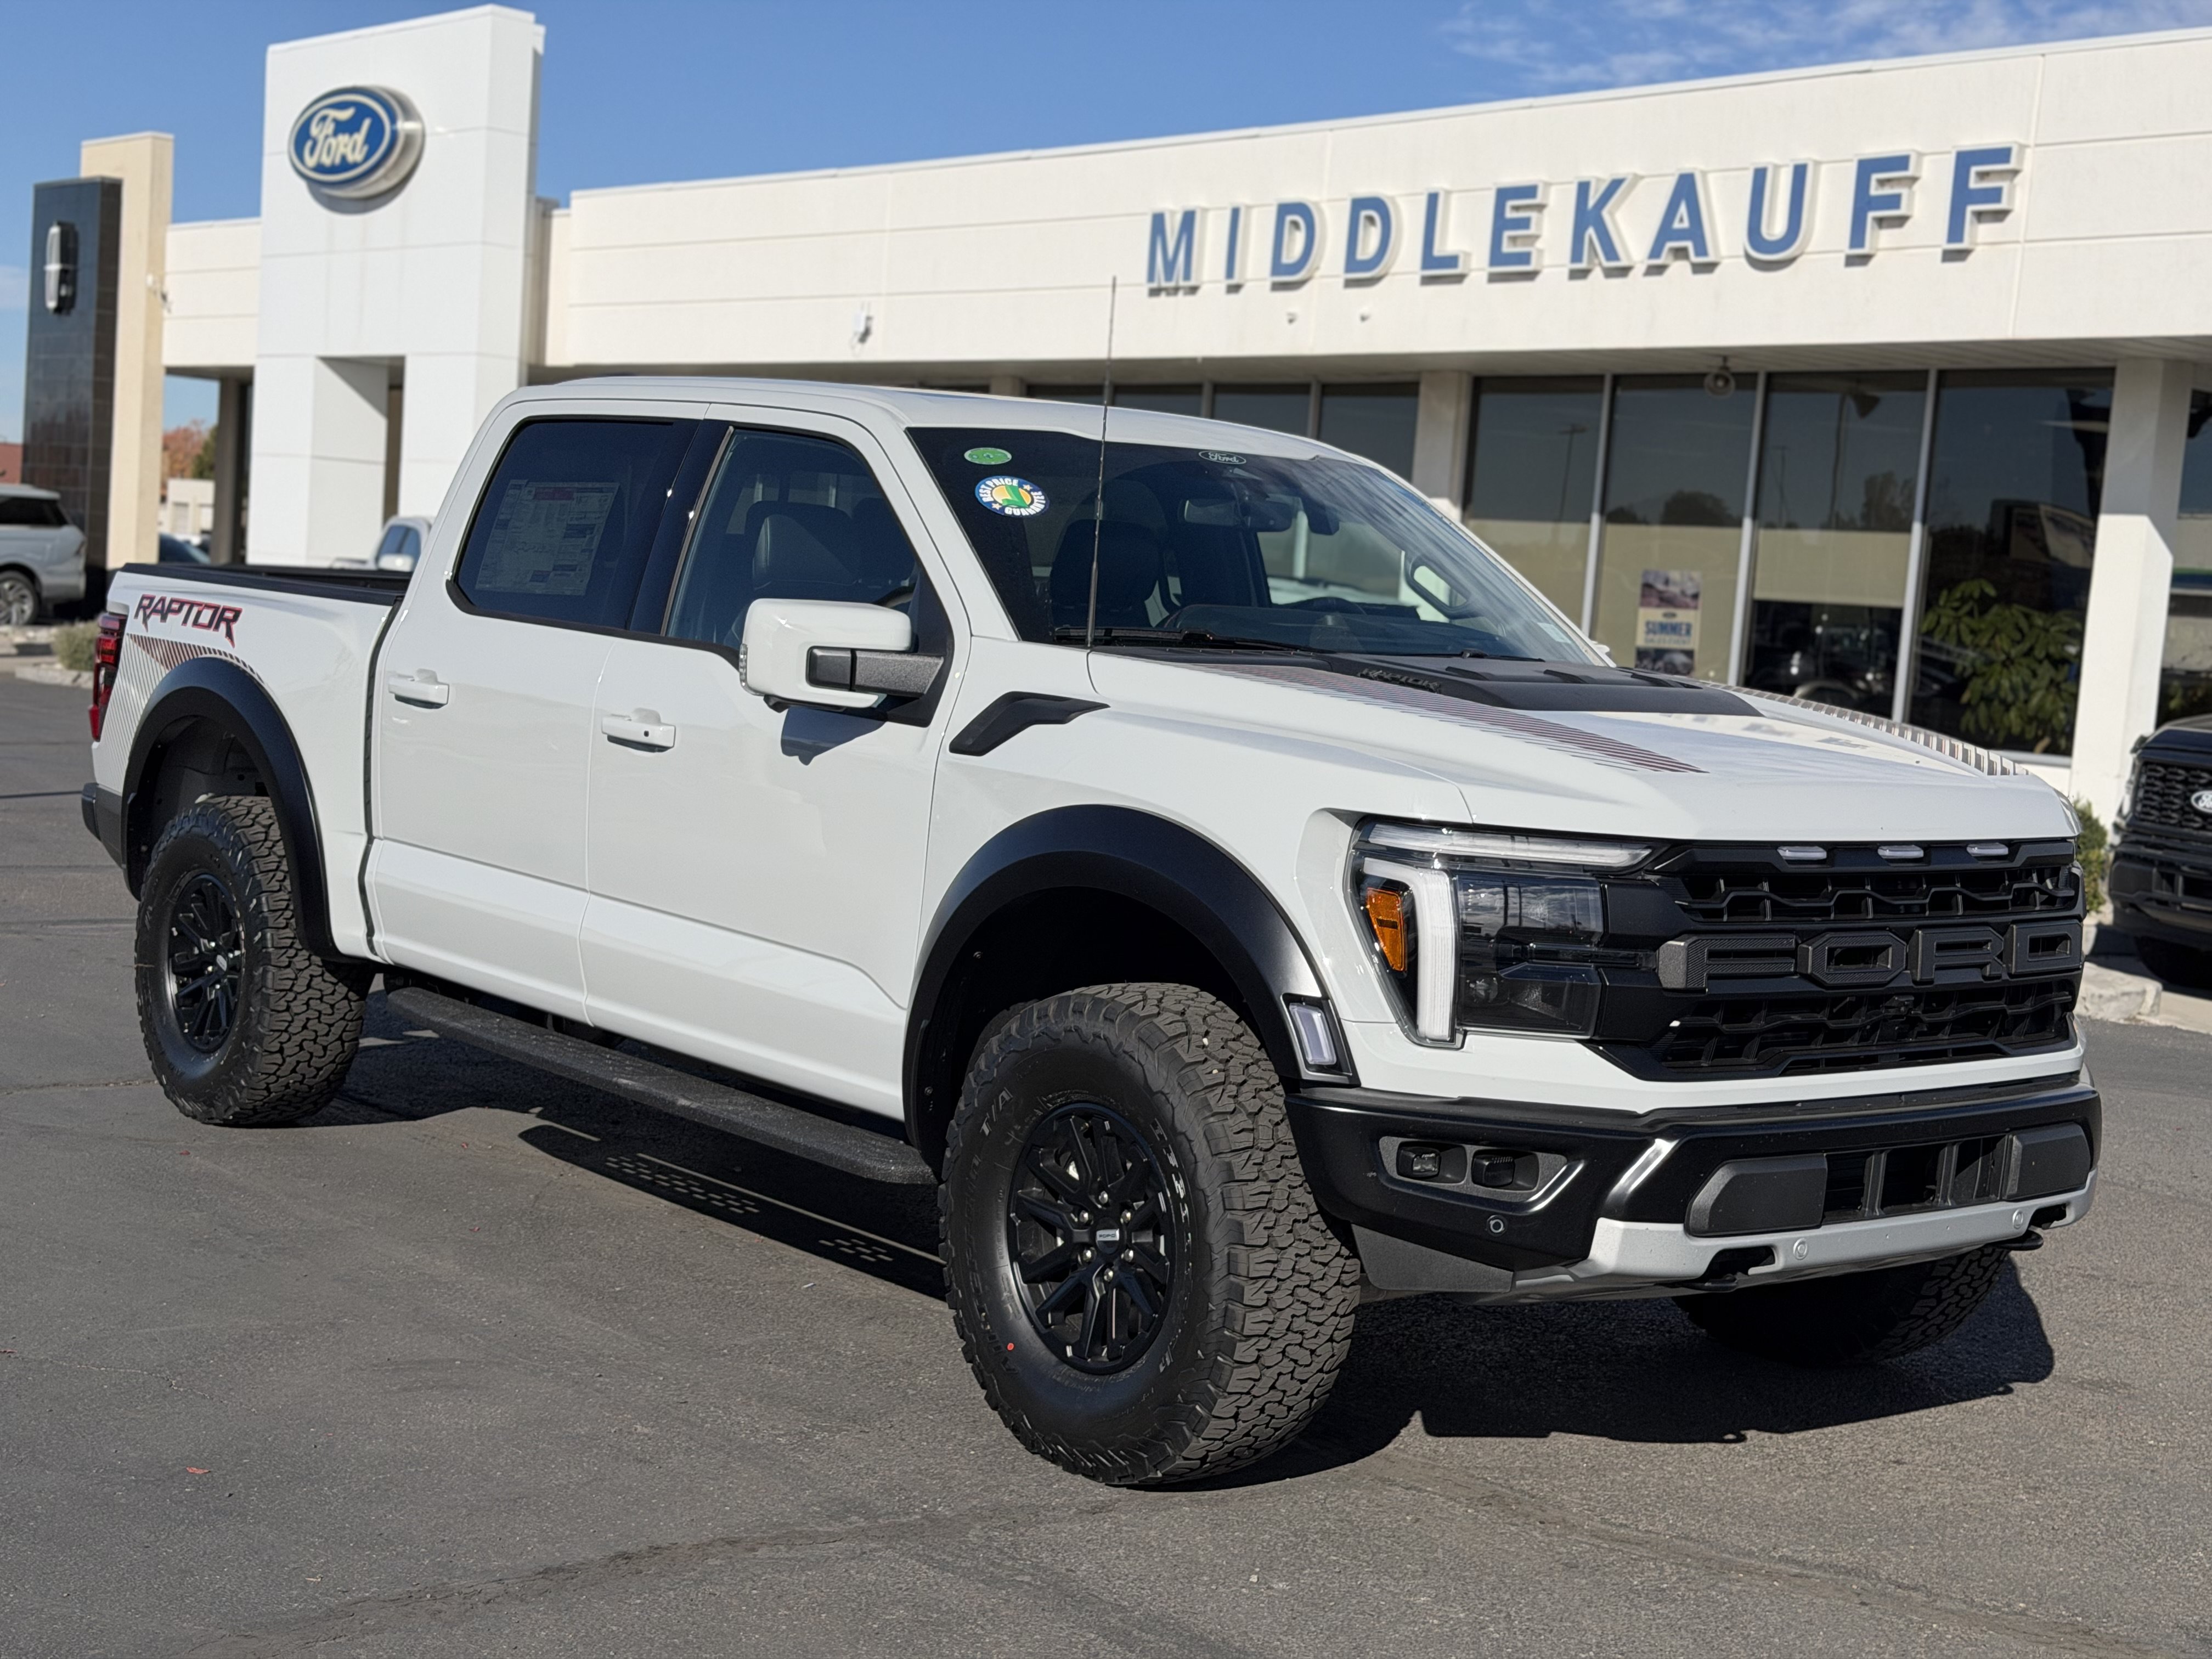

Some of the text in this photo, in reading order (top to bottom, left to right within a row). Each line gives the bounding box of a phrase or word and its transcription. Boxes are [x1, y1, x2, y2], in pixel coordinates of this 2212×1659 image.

[304, 106, 371, 167] Ford
[1146, 145, 2019, 287] MIDDLEKAUFF
[1208, 452, 1239, 462] Ford
[979, 478, 1019, 502] BEST PRICE
[1005, 490, 1046, 516] GUARANTEE
[134, 594, 242, 648] RAPTOR
[1645, 620, 1692, 637] SUMMER
[1657, 919, 2084, 994] FORD
